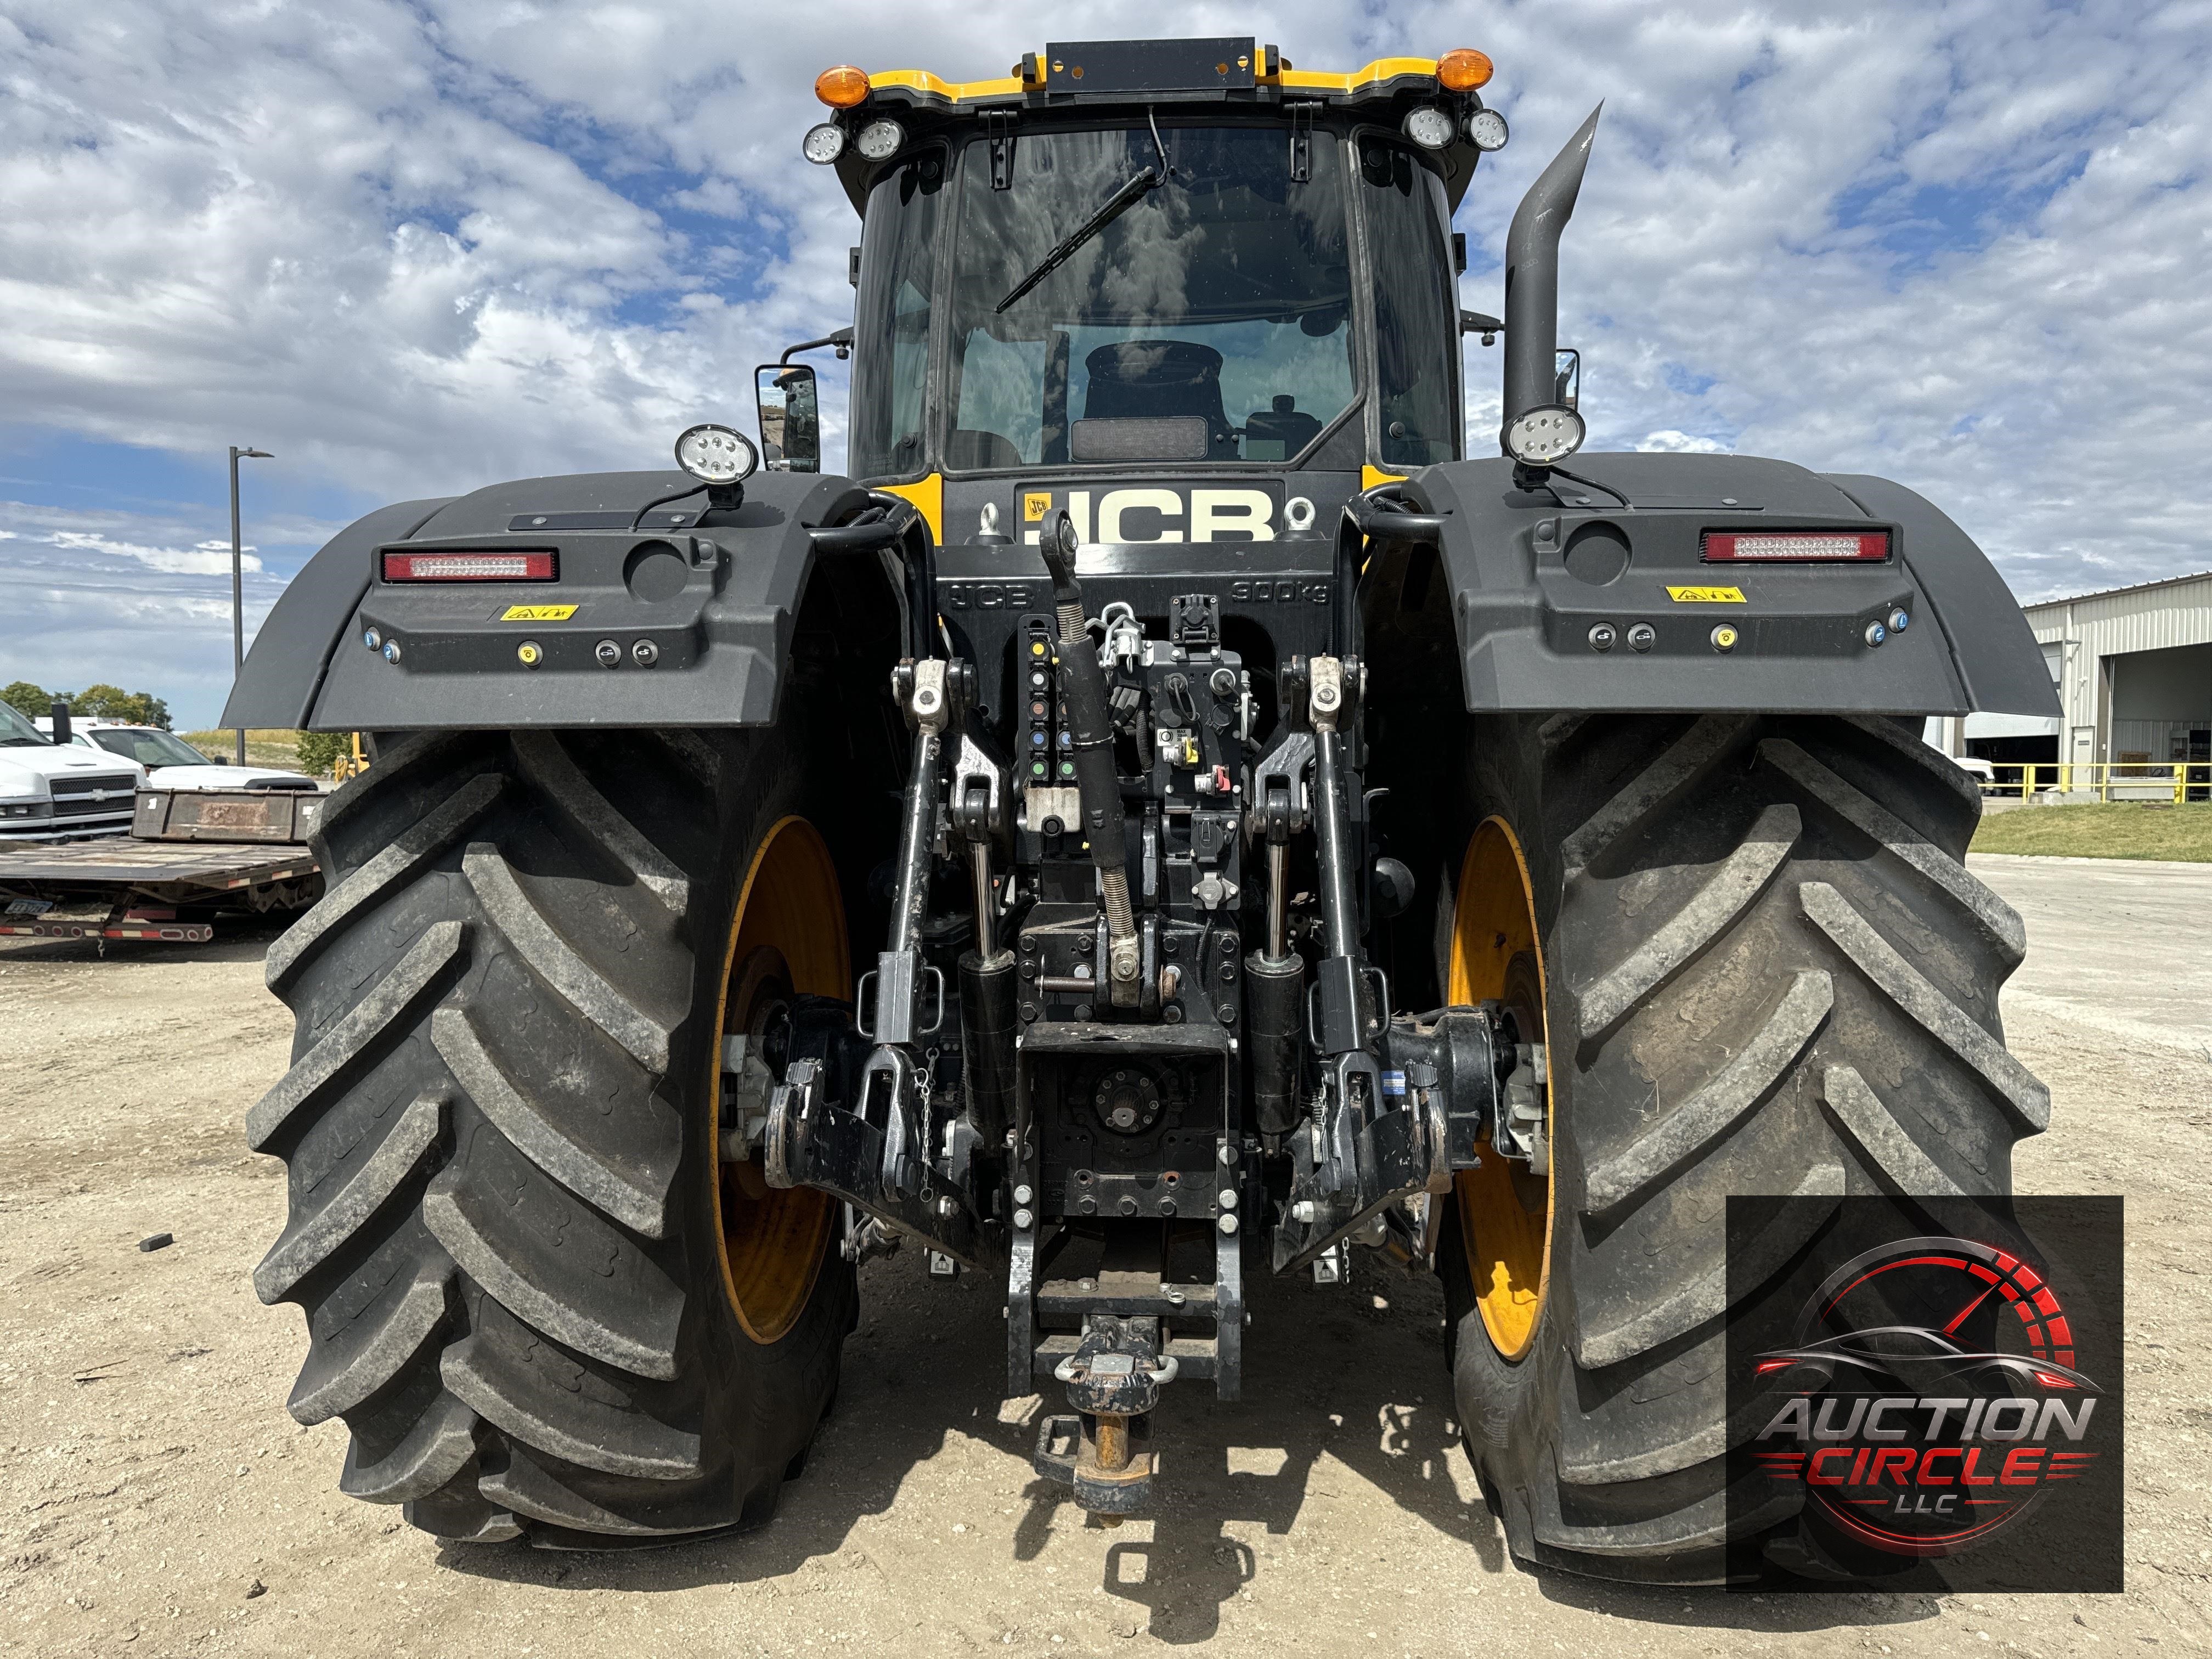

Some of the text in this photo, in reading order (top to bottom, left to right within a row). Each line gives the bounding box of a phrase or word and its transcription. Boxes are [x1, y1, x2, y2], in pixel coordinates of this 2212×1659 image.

[1024, 489, 1275, 545] JCB
[1031, 500, 1047, 514] JCB
[950, 585, 1034, 610] JCB
